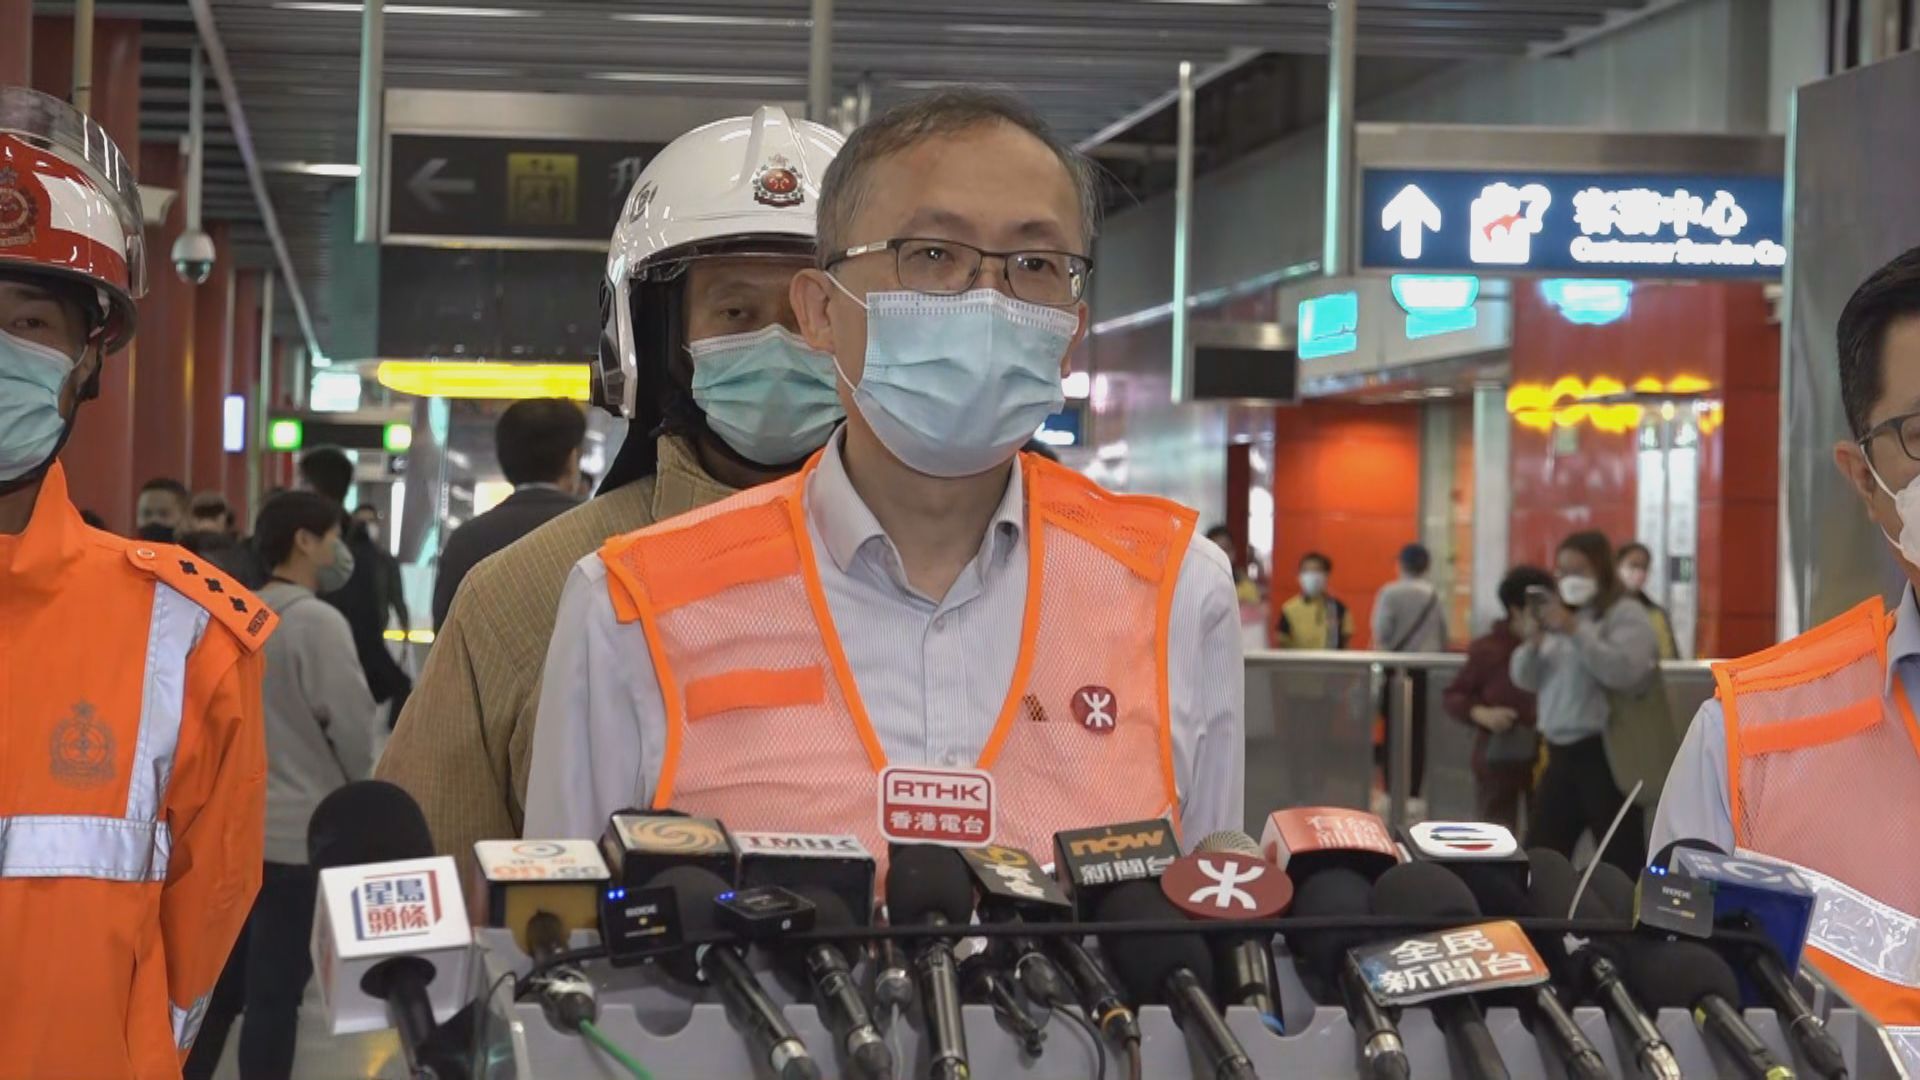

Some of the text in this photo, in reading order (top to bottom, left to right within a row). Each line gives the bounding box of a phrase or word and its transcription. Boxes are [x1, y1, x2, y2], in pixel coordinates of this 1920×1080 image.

[893, 780, 982, 802] RTHK
[890, 811, 985, 835] 香港電台
[1070, 830, 1164, 857] now
[1080, 856, 1176, 885] 新聞台
[365, 879, 426, 905] 星島
[367, 904, 430, 935] 頭條
[1390, 930, 1494, 965] 全民
[1377, 952, 1533, 994] 新聞台
